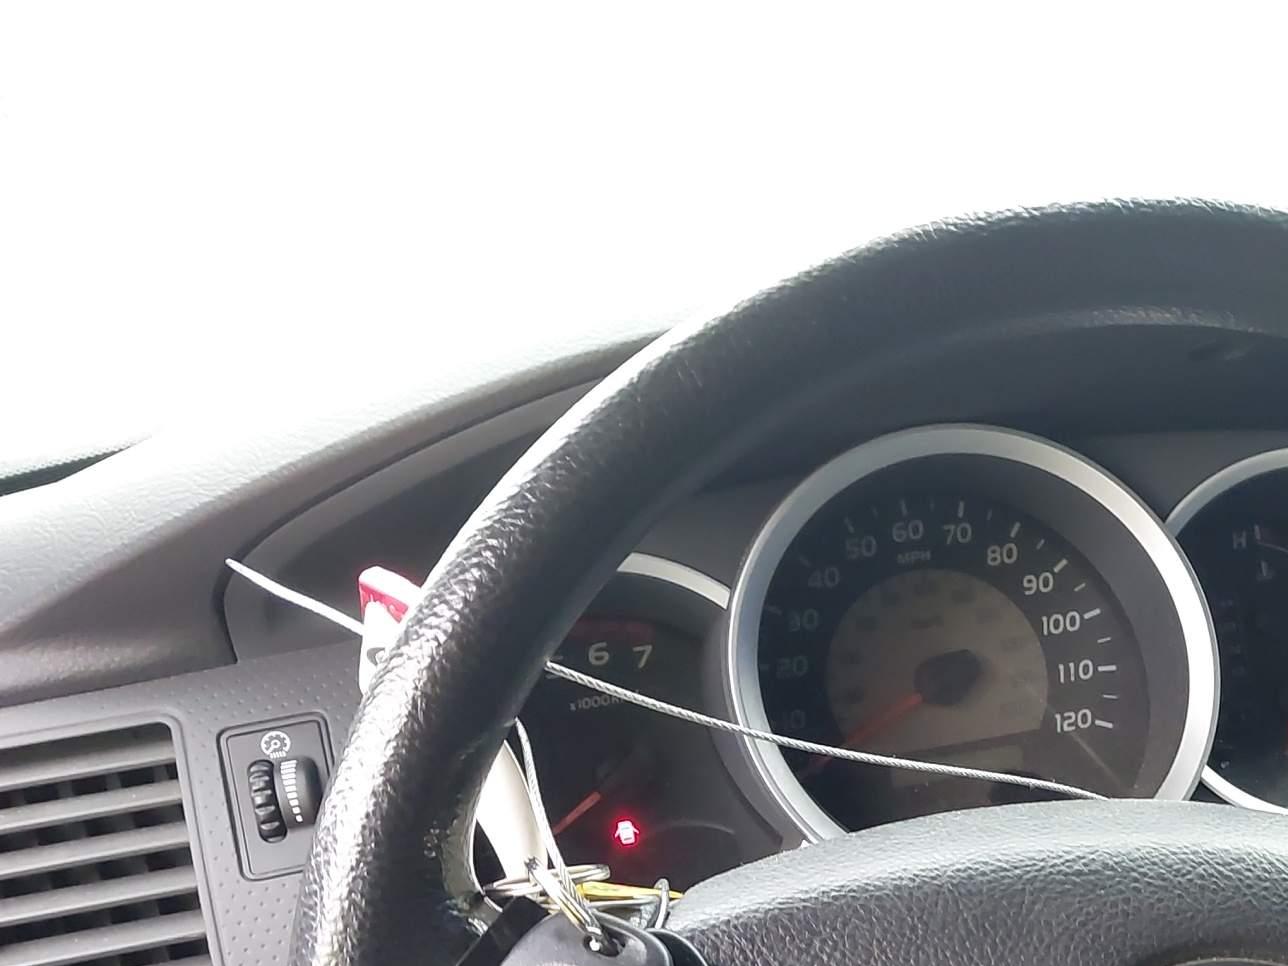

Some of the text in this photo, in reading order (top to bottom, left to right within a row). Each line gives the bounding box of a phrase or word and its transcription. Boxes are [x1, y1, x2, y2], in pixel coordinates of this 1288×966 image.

[892, 519, 924, 543] 60
[943, 522, 972, 544] 70
[846, 535, 877, 560] 50
[897, 550, 931, 564] MPH
[986, 543, 1018, 566] 80
[1023, 572, 1053, 595] 90
[1042, 611, 1080, 636] 100
[588, 642, 653, 668] 6 7
[1058, 659, 1093, 683] 110
[1055, 709, 1092, 732] 120
